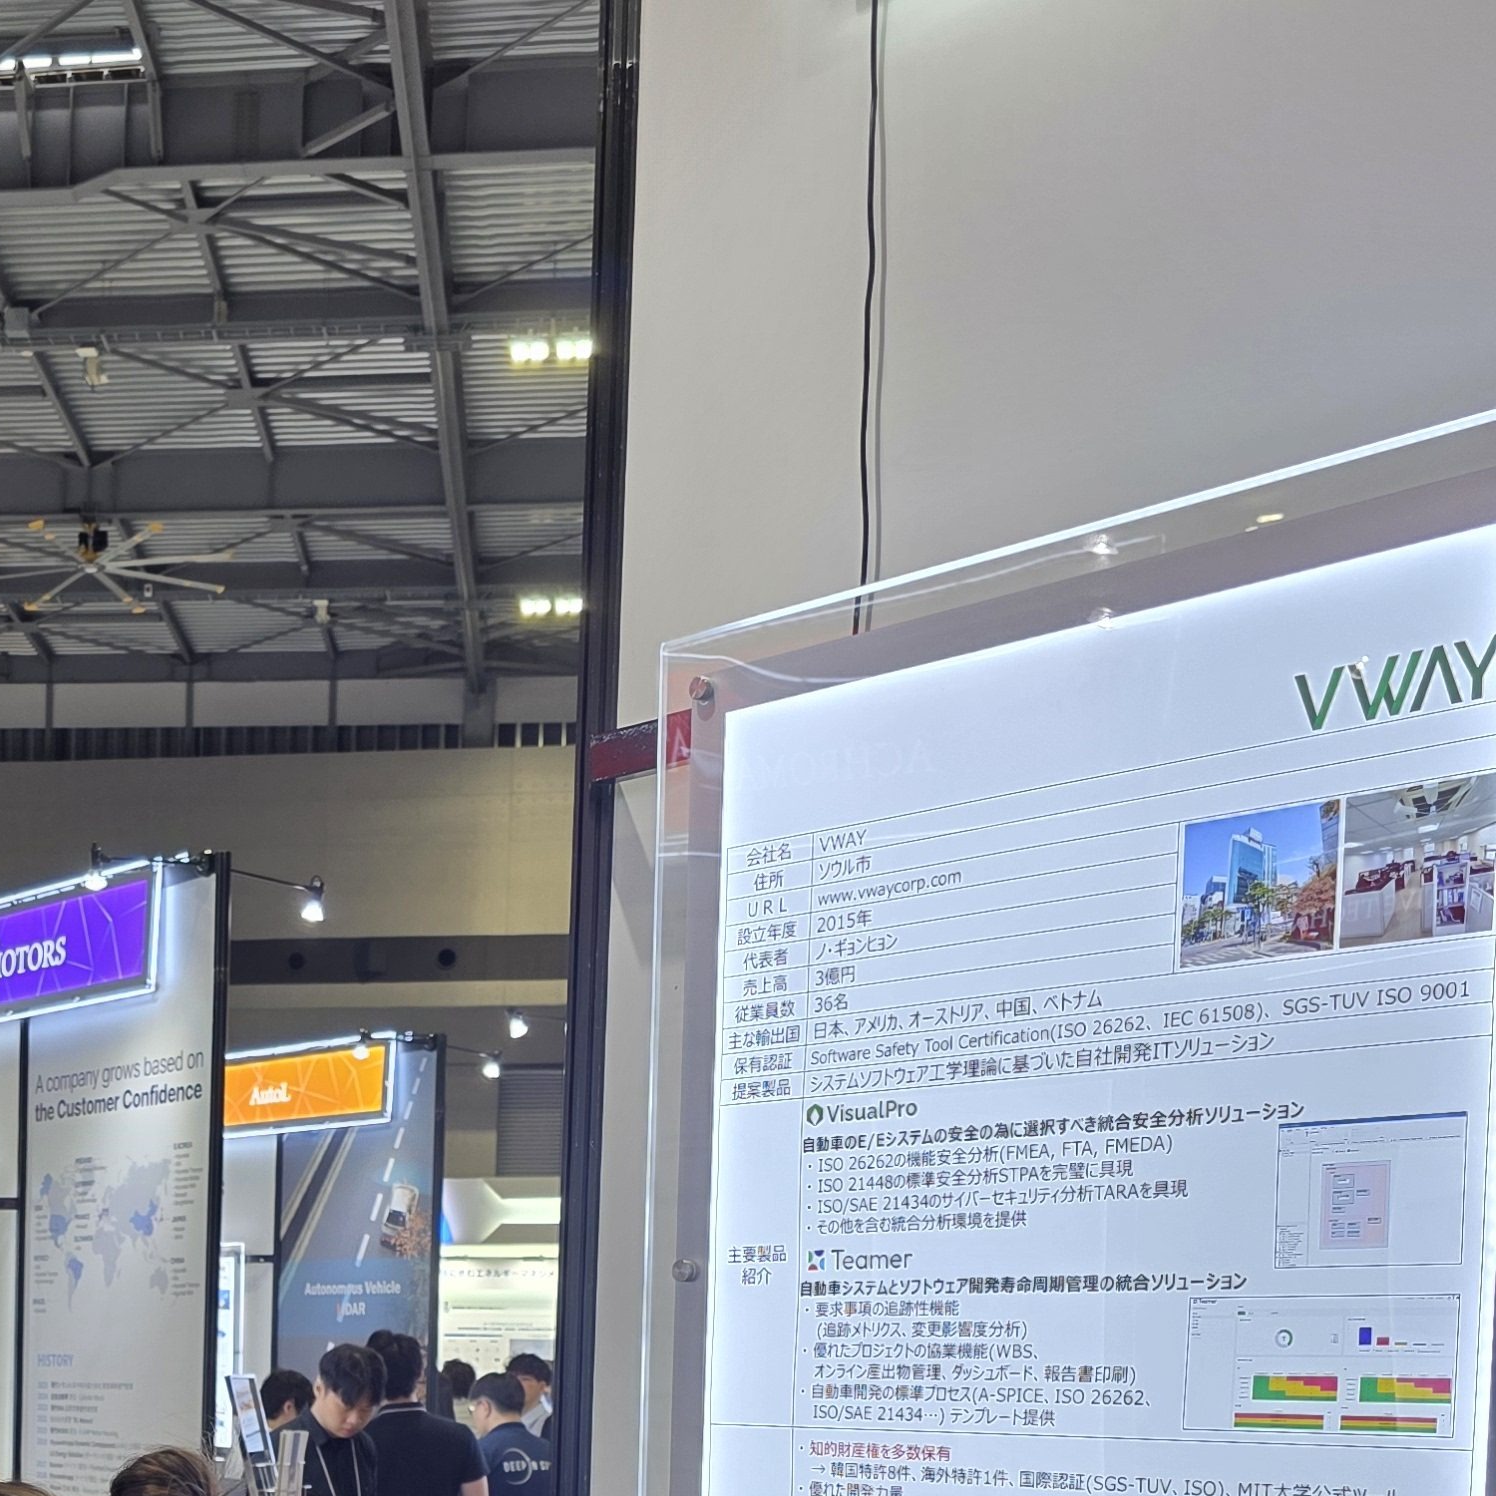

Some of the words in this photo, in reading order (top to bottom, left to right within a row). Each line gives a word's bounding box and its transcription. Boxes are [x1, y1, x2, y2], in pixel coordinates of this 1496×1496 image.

[1294, 634, 1496, 732] VWAY
[819, 829, 867, 852] VWAY
[746, 843, 792, 867] 会社名
[819, 857, 872, 881] ソウル市
[753, 870, 784, 891] 住所
[817, 870, 962, 907] www.vwaycorp.com
[737, 921, 798, 945] 設立年度
[817, 910, 872, 934] 2015年
[743, 948, 788, 970] 代表者
[743, 974, 788, 996] 売上高
[815, 967, 856, 987] 3億円
[734, 1000, 795, 1022] 従業員数
[814, 993, 849, 1012] 36名
[810, 1045, 872, 1066] Software
[875, 1041, 920, 1062] Safety
[925, 1036, 953, 1053] Tool
[1163, 1010, 1194, 1028] IEC
[1282, 990, 1371, 1017] SGS-TUV
[1375, 986, 1412, 1006] ISO
[1420, 979, 1470, 1003] 9001
[728, 1025, 801, 1049] 主な輸出国
[35, 1074, 45, 1094] A
[46, 1069, 100, 1092] company
[102, 1060, 141, 1088] grows
[143, 1050, 184, 1077] based
[186, 1050, 204, 1069] on
[733, 1052, 793, 1074] 保有認証
[731, 1079, 791, 1101] 提案製品
[35, 1101, 55, 1122] the
[57, 1095, 120, 1119] Customer
[122, 1082, 203, 1110] Confidence
[826, 1100, 919, 1124] VisualPro
[818, 1157, 844, 1173] ISO
[1061, 1141, 1098, 1159] FTA,
[1106, 1134, 1173, 1154] FMEDA)
[818, 1178, 844, 1194] ISO
[817, 1197, 878, 1216] ISO/SAE
[816, 1210, 1027, 1235] その他を含む統合分析環境を提供
[728, 1245, 787, 1264] 主要製品
[831, 1249, 913, 1271] Teamer
[741, 1267, 772, 1286] 紹介
[305, 1281, 363, 1296] Autonomous
[364, 1280, 401, 1295] Vehicle
[815, 1299, 960, 1318] 要求事項の追跡性機能
[37, 1354, 74, 1368] HISTORY
[812, 1403, 873, 1422] ISO/SAE
[950, 1408, 1056, 1427] テンプレート提供
[808, 1440, 951, 1462] 知的財産権を多数保有
